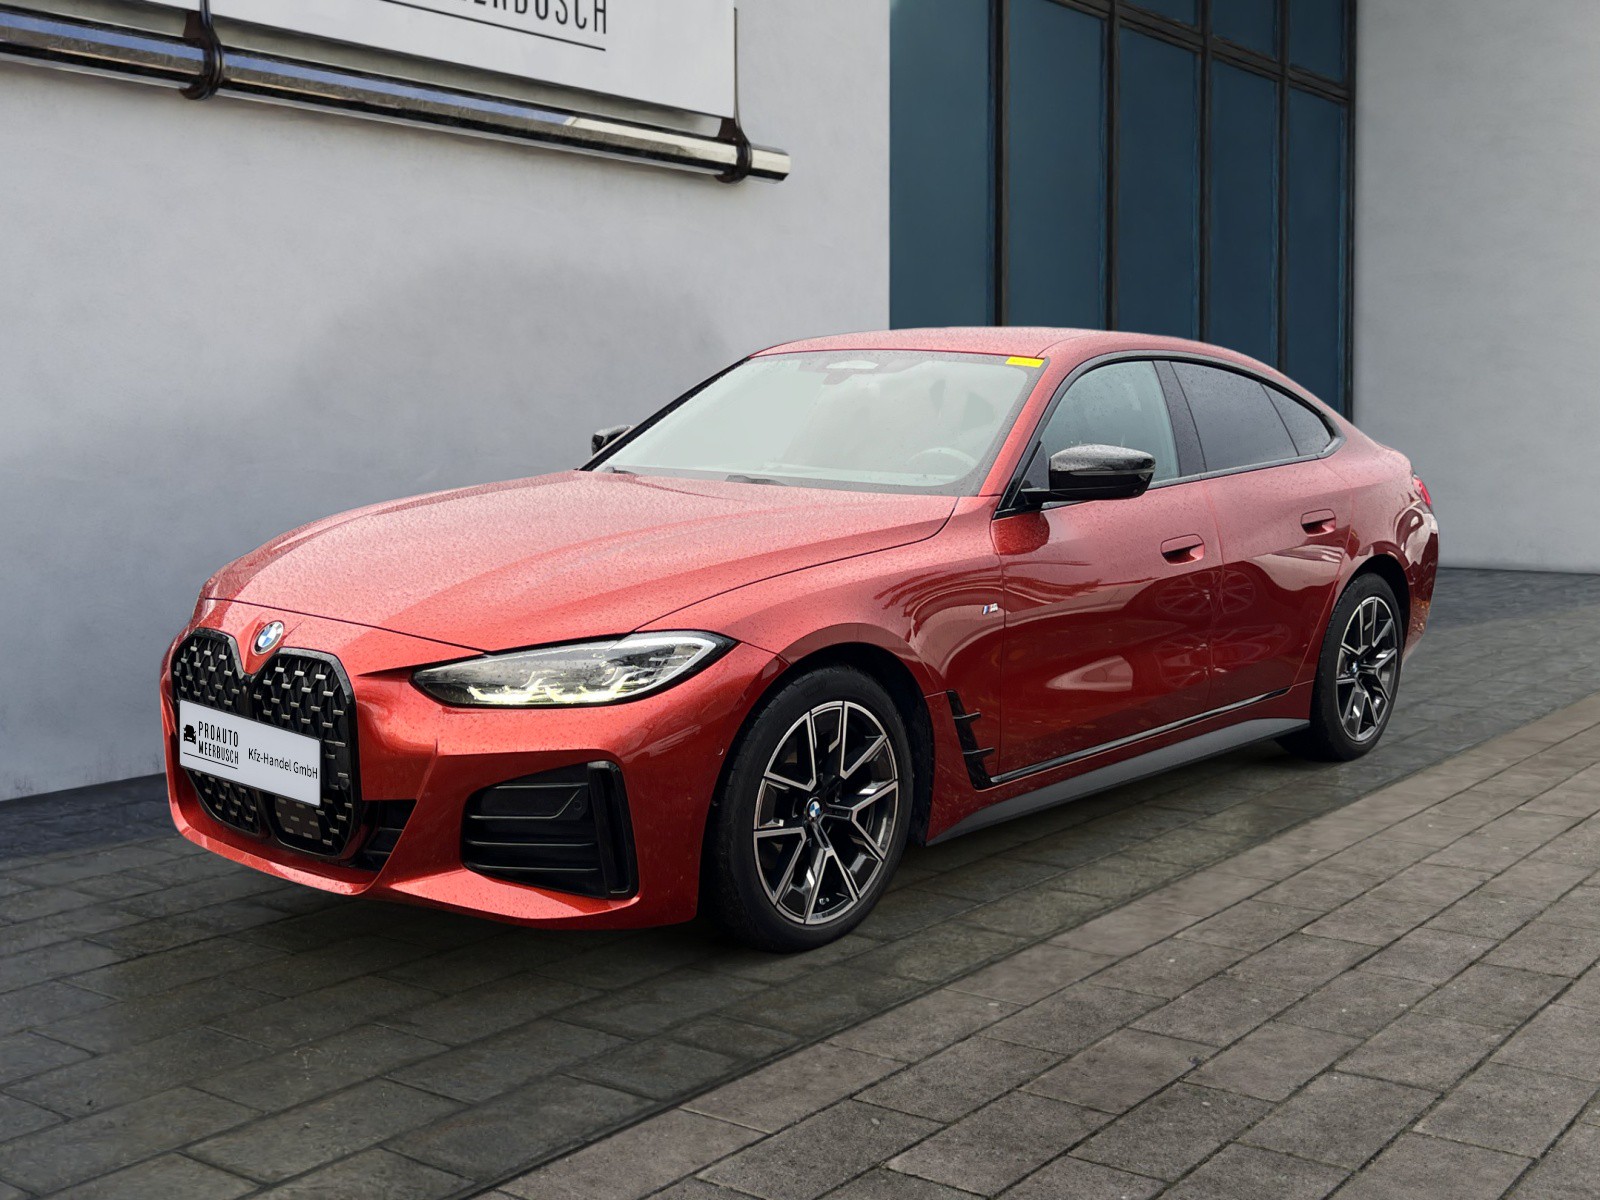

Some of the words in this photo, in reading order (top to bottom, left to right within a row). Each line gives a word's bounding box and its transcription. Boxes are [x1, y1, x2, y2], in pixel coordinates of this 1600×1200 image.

[198, 721, 239, 747] PROAUTO
[198, 741, 239, 765] MEERBUSCH
[248, 747, 292, 772] Kfz-Handel
[293, 762, 318, 779] GmbH
